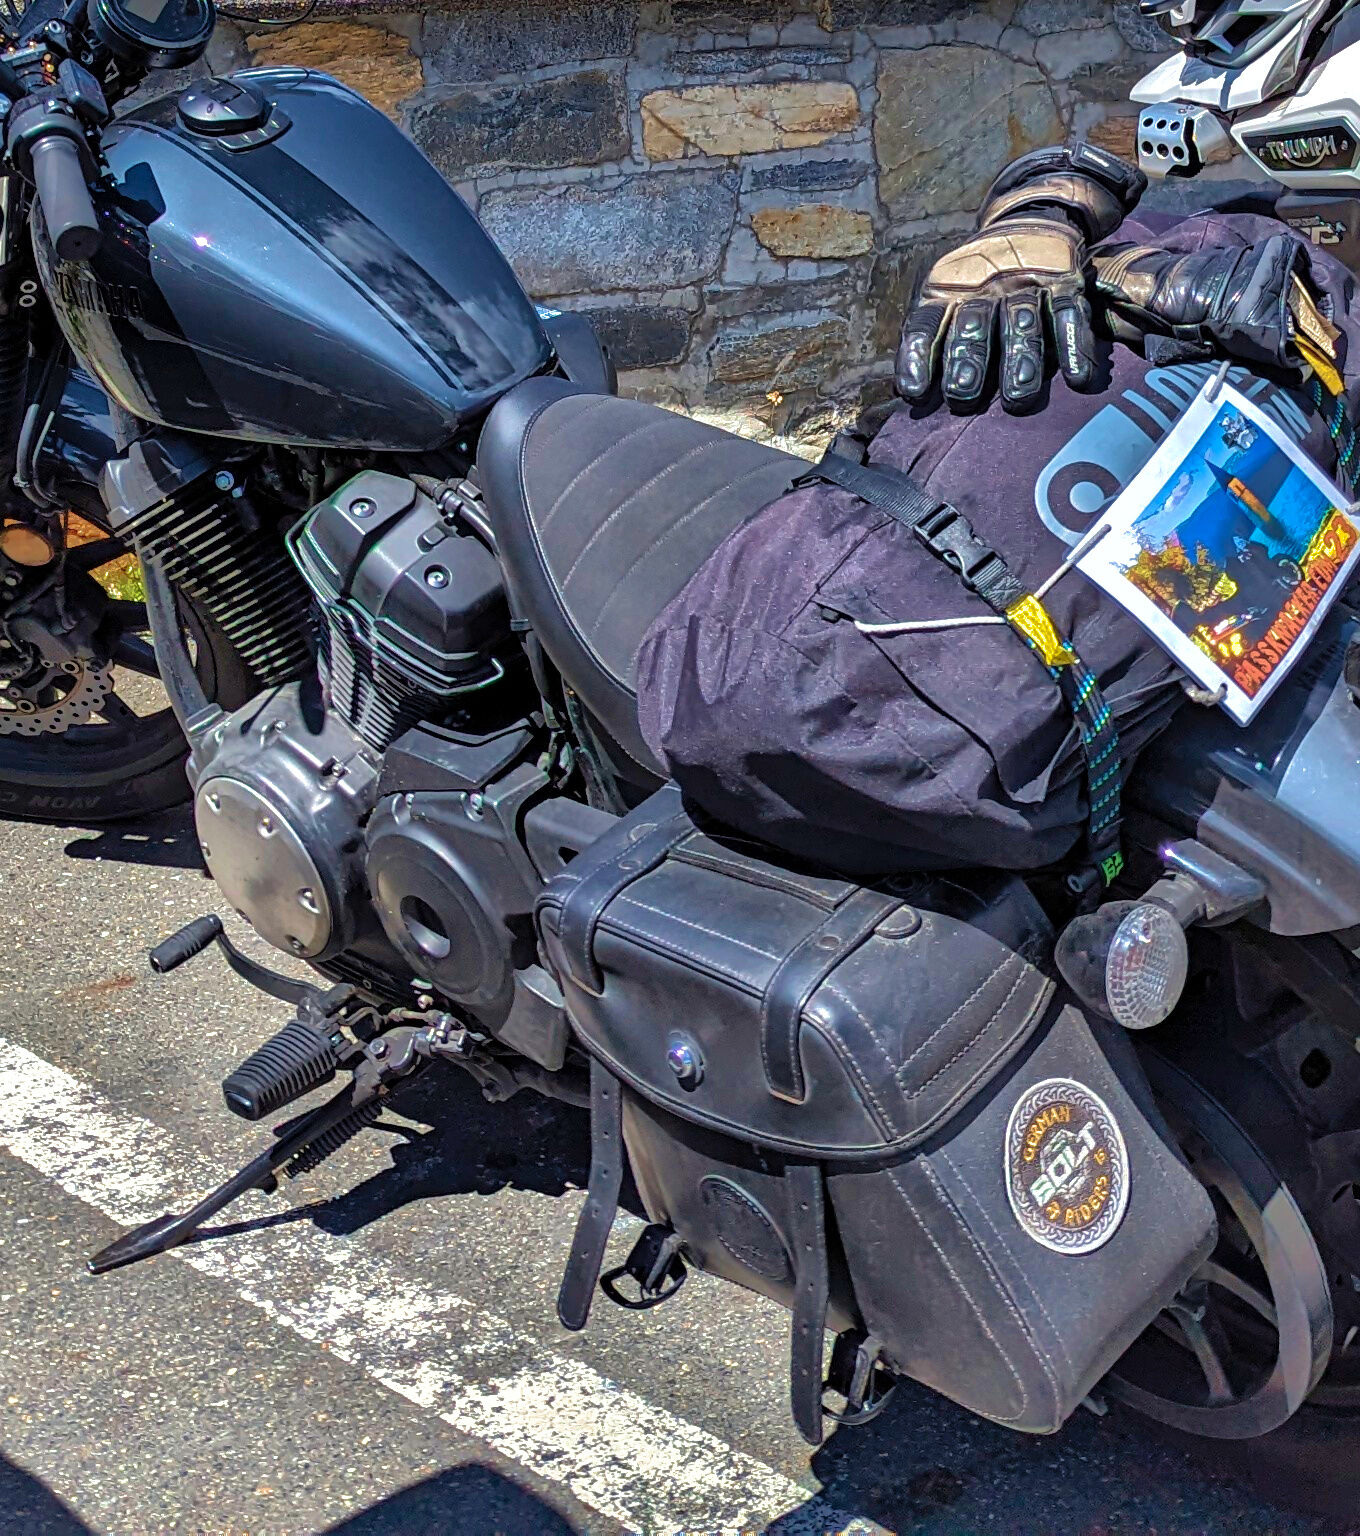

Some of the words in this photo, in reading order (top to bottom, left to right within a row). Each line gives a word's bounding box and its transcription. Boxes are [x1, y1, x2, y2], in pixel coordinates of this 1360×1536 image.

[1266, 135, 1338, 160] TRIUMPH
[1068, 322, 1080, 375] VANUCCI
[1022, 1105, 1071, 1162] GERMAN
[1029, 1121, 1096, 1207] BOLT
[1063, 1175, 1110, 1227] RIDERS
